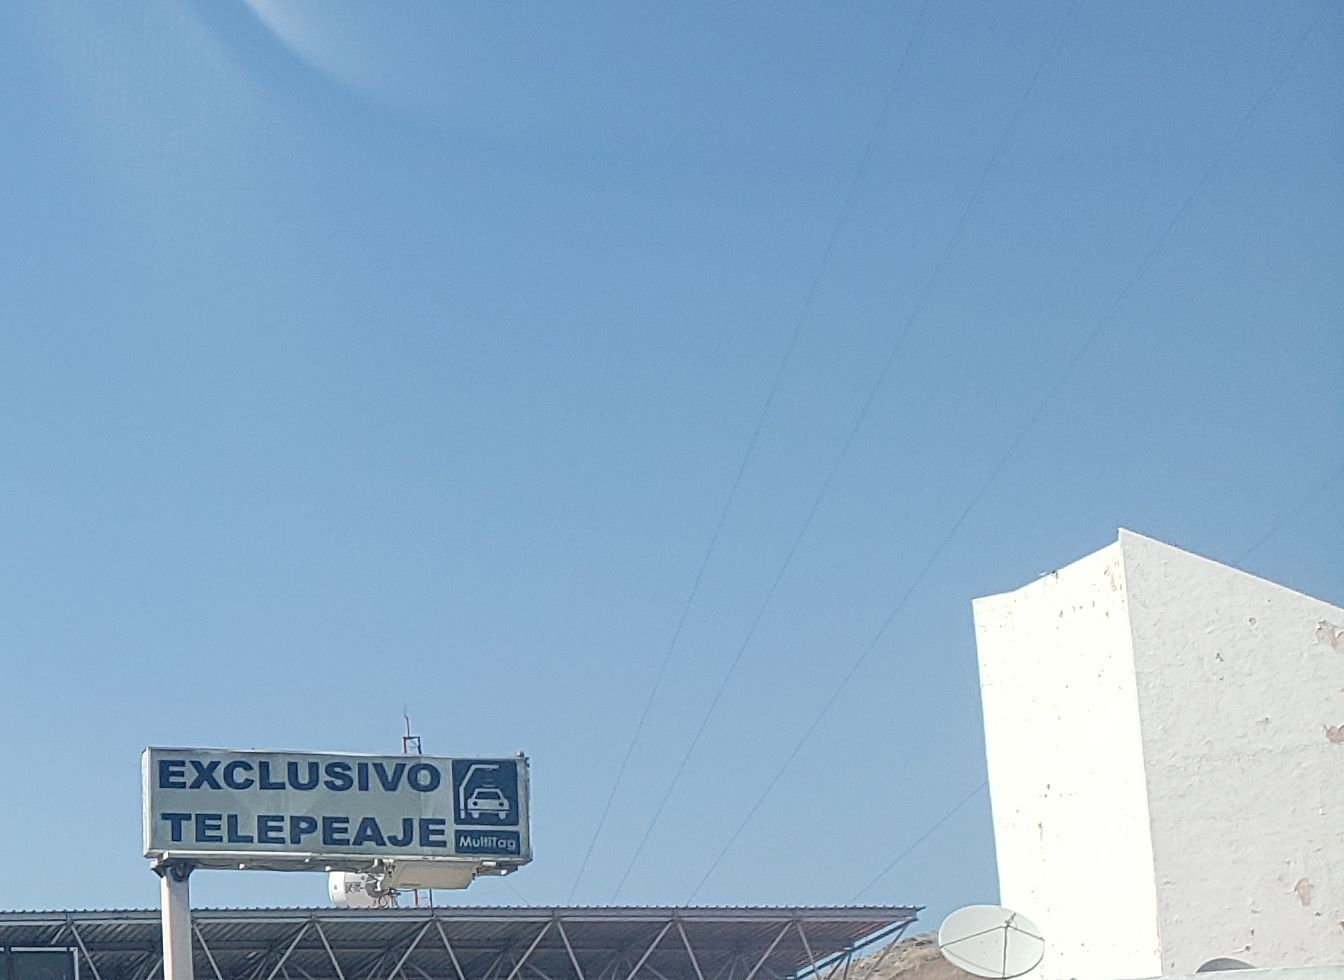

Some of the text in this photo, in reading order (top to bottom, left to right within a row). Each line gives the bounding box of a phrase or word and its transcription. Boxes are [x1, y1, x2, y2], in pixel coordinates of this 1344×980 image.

[157, 759, 441, 793] EXCLUSIVO
[160, 812, 448, 848] TELEPEAJE
[458, 835, 517, 851] MultiTag
